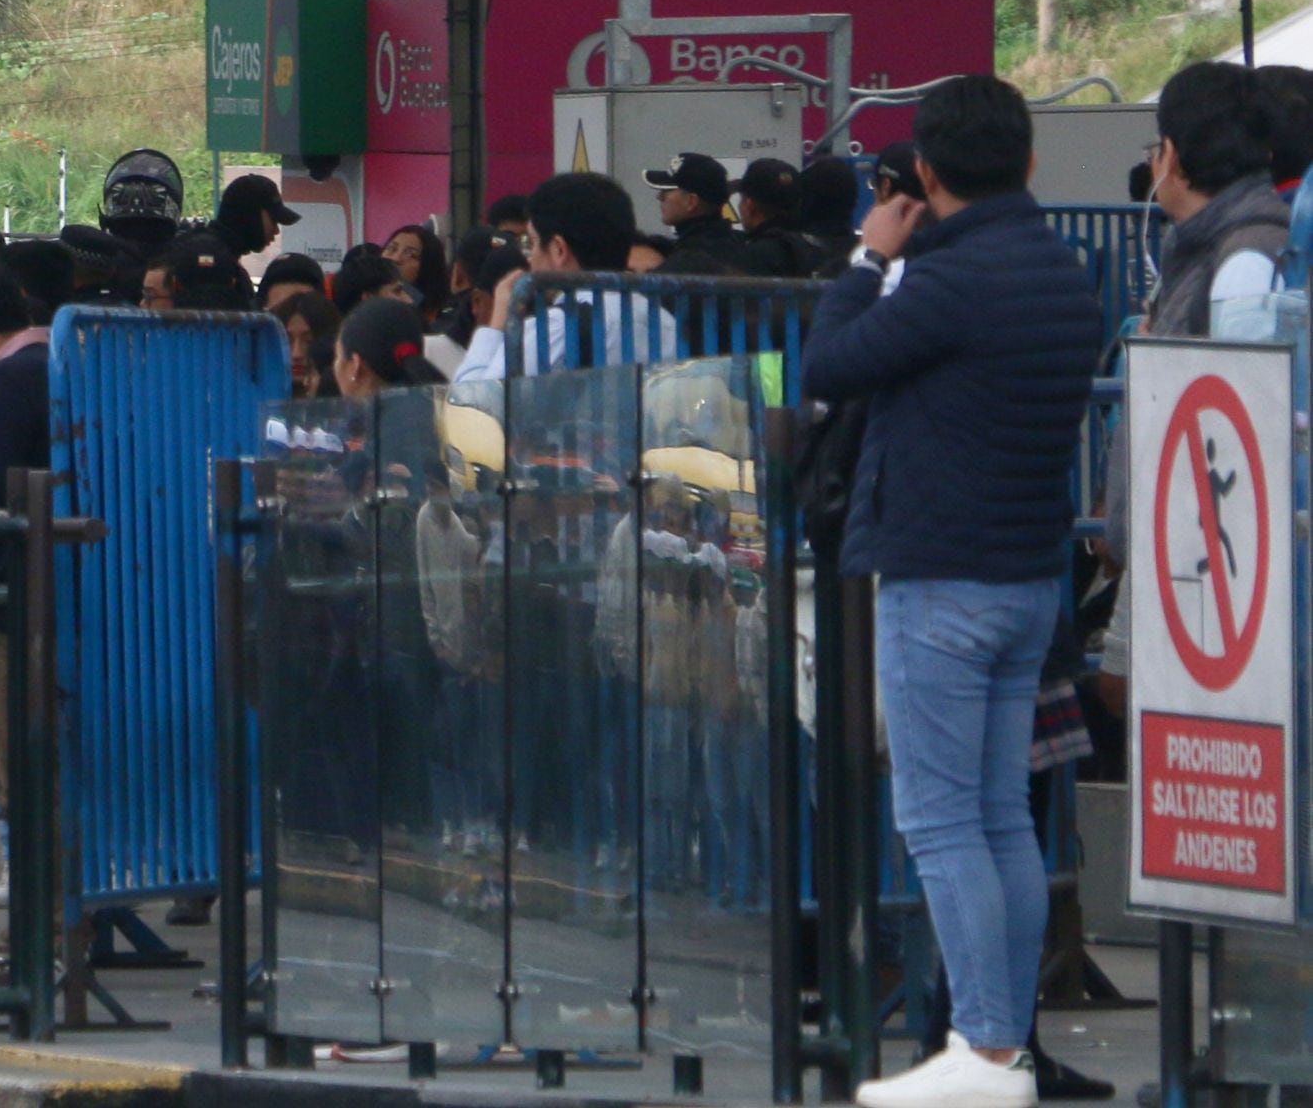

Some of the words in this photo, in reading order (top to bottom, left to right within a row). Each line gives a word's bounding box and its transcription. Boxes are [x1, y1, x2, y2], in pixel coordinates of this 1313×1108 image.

[212, 25, 261, 94] Cajeros
[669, 38, 805, 72] Banco
[1166, 733, 1262, 779] PROHIBIDO
[1152, 779, 1240, 825] SALTARSE
[1244, 788, 1277, 830] LOS
[1174, 828, 1257, 875] ANDENES
